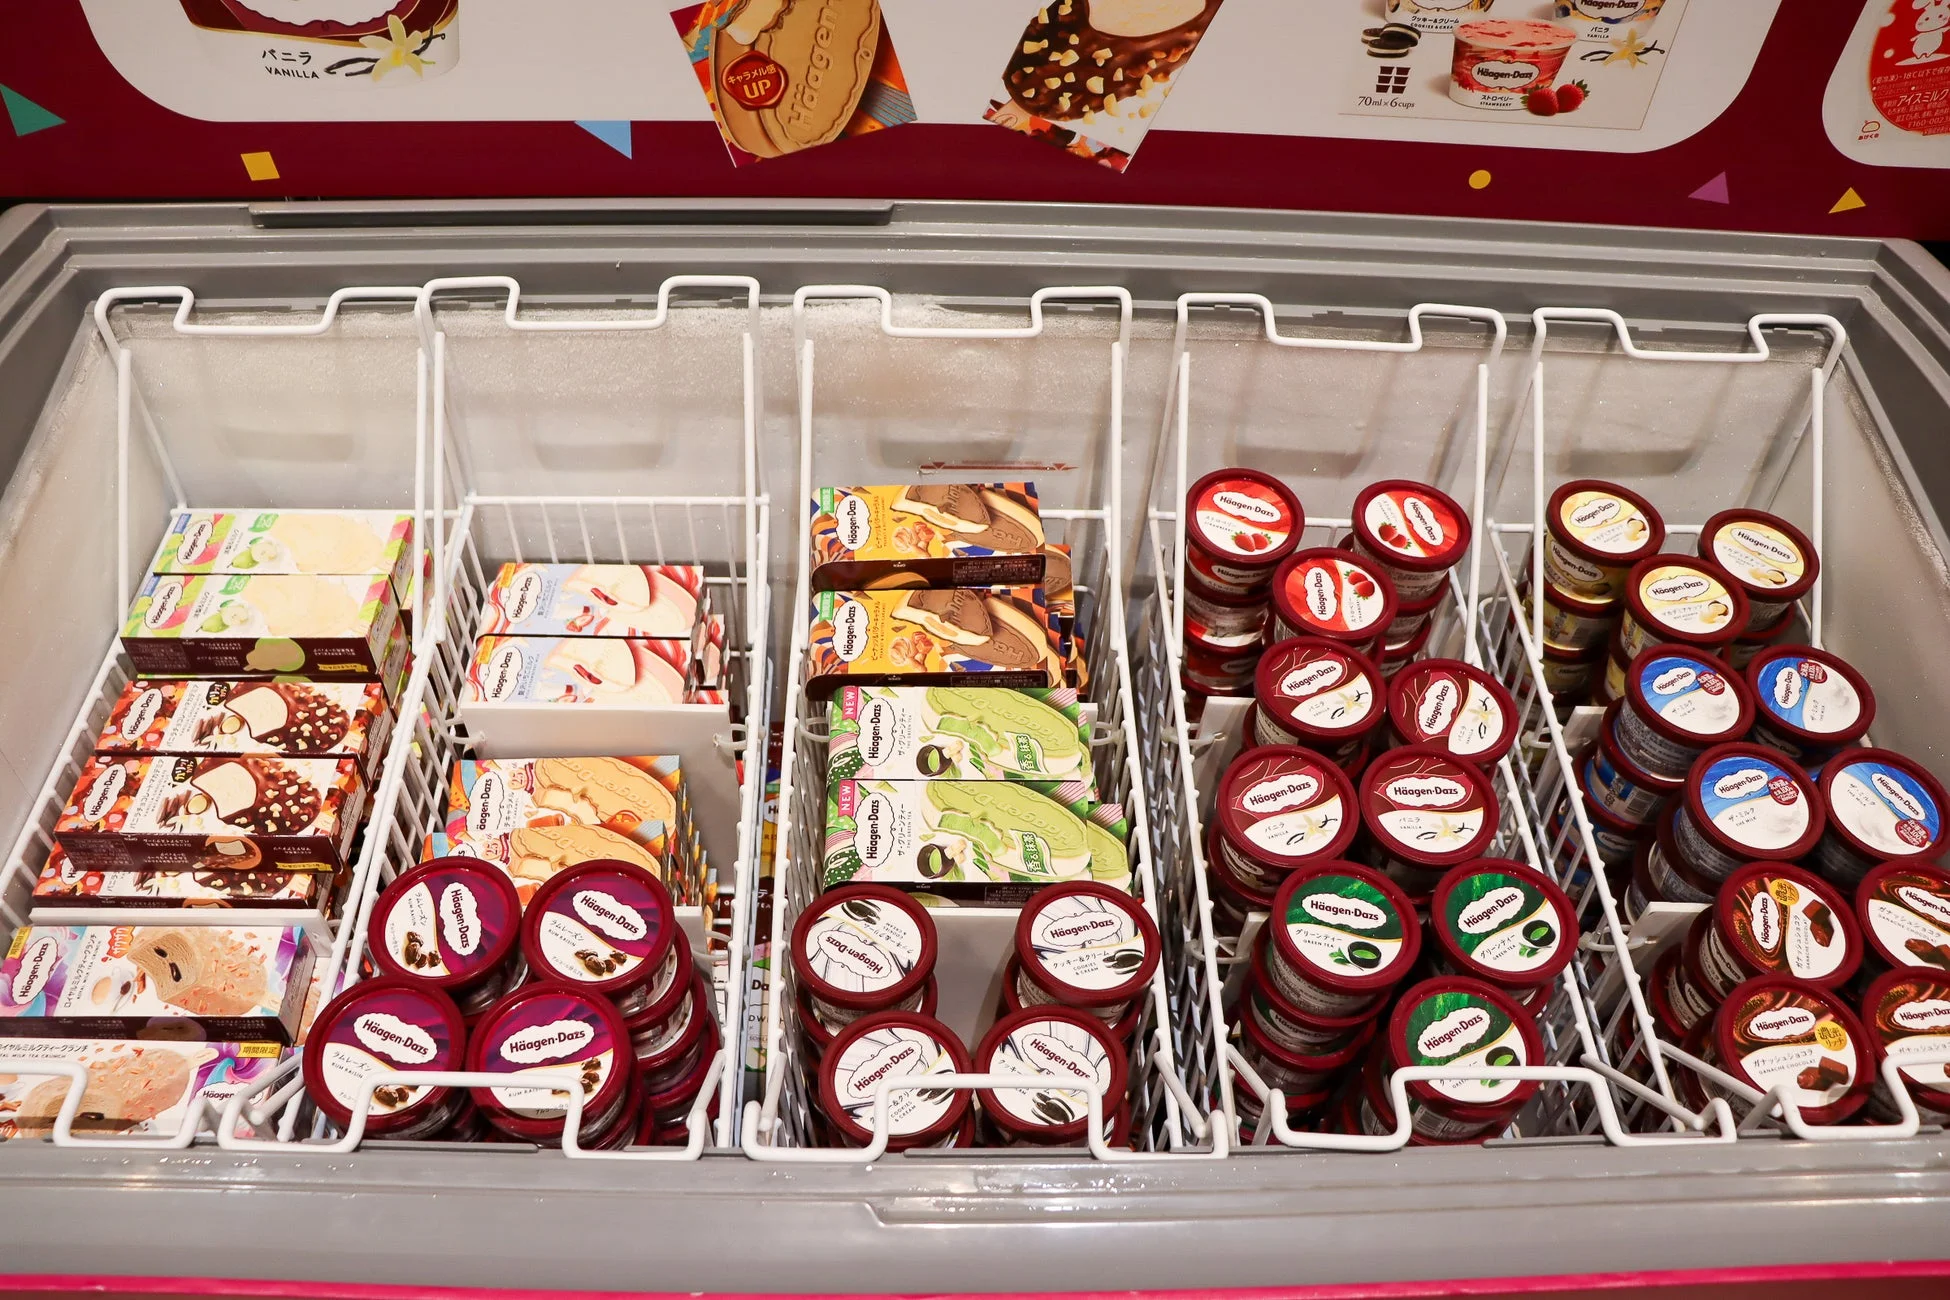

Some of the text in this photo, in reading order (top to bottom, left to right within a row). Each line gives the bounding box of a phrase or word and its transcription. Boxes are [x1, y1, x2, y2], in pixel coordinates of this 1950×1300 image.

[261, 48, 312, 66] バニラ
[264, 65, 320, 80] VANILLA
[727, 63, 777, 85] キャラメル感
[1476, 66, 1534, 80] Häagen-Dazs
[743, 79, 771, 99] UP
[1481, 94, 1515, 102] ストロベリー
[1896, 88, 1950, 108] アイスミルク
[1218, 494, 1275, 519] Häagen-Dazs
[1574, 501, 1616, 524] Häagen-Dazs
[847, 498, 858, 546] Häagen-Dazs
[1410, 500, 1437, 542] Häagen-Dazs
[1737, 530, 1792, 561] Häagen-Dazs
[1552, 544, 1599, 579] Häagen-Dazs
[512, 576, 534, 619] Häagen-Dazs
[1315, 571, 1328, 616] Häagen-Dazs
[1652, 579, 1705, 597] Häagen-Dazs
[843, 604, 857, 657] Häagen-Dazs
[491, 651, 514, 699] Häagen-Dazs
[1285, 663, 1338, 693] Häagen-Dazs
[1655, 669, 1692, 692] Häagen-Dazs
[1780, 669, 1795, 706] Häagen-Dazs
[127, 693, 156, 736] Häagen-Dazs
[844, 690, 854, 716] NEW
[1307, 700, 1326, 712] バニラ
[1424, 683, 1450, 730] Häagen-Dazs
[867, 703, 882, 760] Häagen-Dazs
[897, 708, 906, 756] ザ・グリーンティー
[1456, 725, 1466, 742] バニラ
[1013, 735, 1035, 771] 香る抹茶
[89, 768, 119, 817] Häagen-Dazs
[840, 784, 852, 810] NEW
[1249, 778, 1312, 807] Häagen-Dazs
[1393, 784, 1459, 797] Häagen-Dazs
[1718, 772, 1764, 795] Häagen-Dazs
[1877, 775, 1921, 817] Häagen-Dazs
[476, 777, 493, 831] äagen-Dazs
[1727, 807, 1756, 822] ザ・ミルク
[865, 798, 880, 860] Häagen-Dazs
[896, 803, 907, 856] ザ・グリーンティー
[1264, 821, 1286, 833] バニラ
[1267, 830, 1289, 840] VANILLA
[1019, 832, 1044, 872] 香る抹茶
[415, 891, 429, 926] ラムレーズン
[449, 887, 471, 950] Häagen-Dazs
[579, 893, 640, 936] Häagen-Dazs
[1310, 899, 1380, 922] Häagen-Dazs
[1462, 891, 1519, 928] Häagen-Dazs
[1760, 896, 1770, 944] Häagen-Dazs
[1876, 905, 1944, 938] ガナッシュショコラ
[549, 919, 586, 942] ラムレーズン
[1049, 917, 1116, 941] Häagen-Dazs
[1295, 928, 1343, 942] グリーンティー
[1793, 914, 1803, 969] ガナッシュショコラ
[825, 935, 883, 974] Häagen-Dazs
[1052, 949, 1110, 968] クッキー&クリーム
[1479, 932, 1517, 960] グリーンティー
[1492, 949, 1508, 961] GREEN
[18, 942, 49, 998] Häagen-Dazs
[62, 933, 99, 1009] ロイヤルミルクティークランチ
[1072, 961, 1097, 971] COOKIES
[1079, 966, 1099, 975] CREAM
[1423, 1013, 1485, 1052] Häagen-Dazs
[1754, 1014, 1810, 1032] Häagen-Dazs
[361, 1018, 429, 1057] Häagen-Dazs
[508, 1027, 587, 1054] Häagen-Dazs
[331, 1061, 364, 1079] RUM RAISIN
[333, 1051, 373, 1073] ラムレーズン
[853, 1046, 916, 1093] Häagen-Dazs
[1753, 1048, 1813, 1067] ガナッシュショコラ
[1759, 1058, 1816, 1075] GANACHE CHOCOLAT
[890, 1099, 912, 1118] COOKIES
[898, 1104, 917, 1120] CREAM
